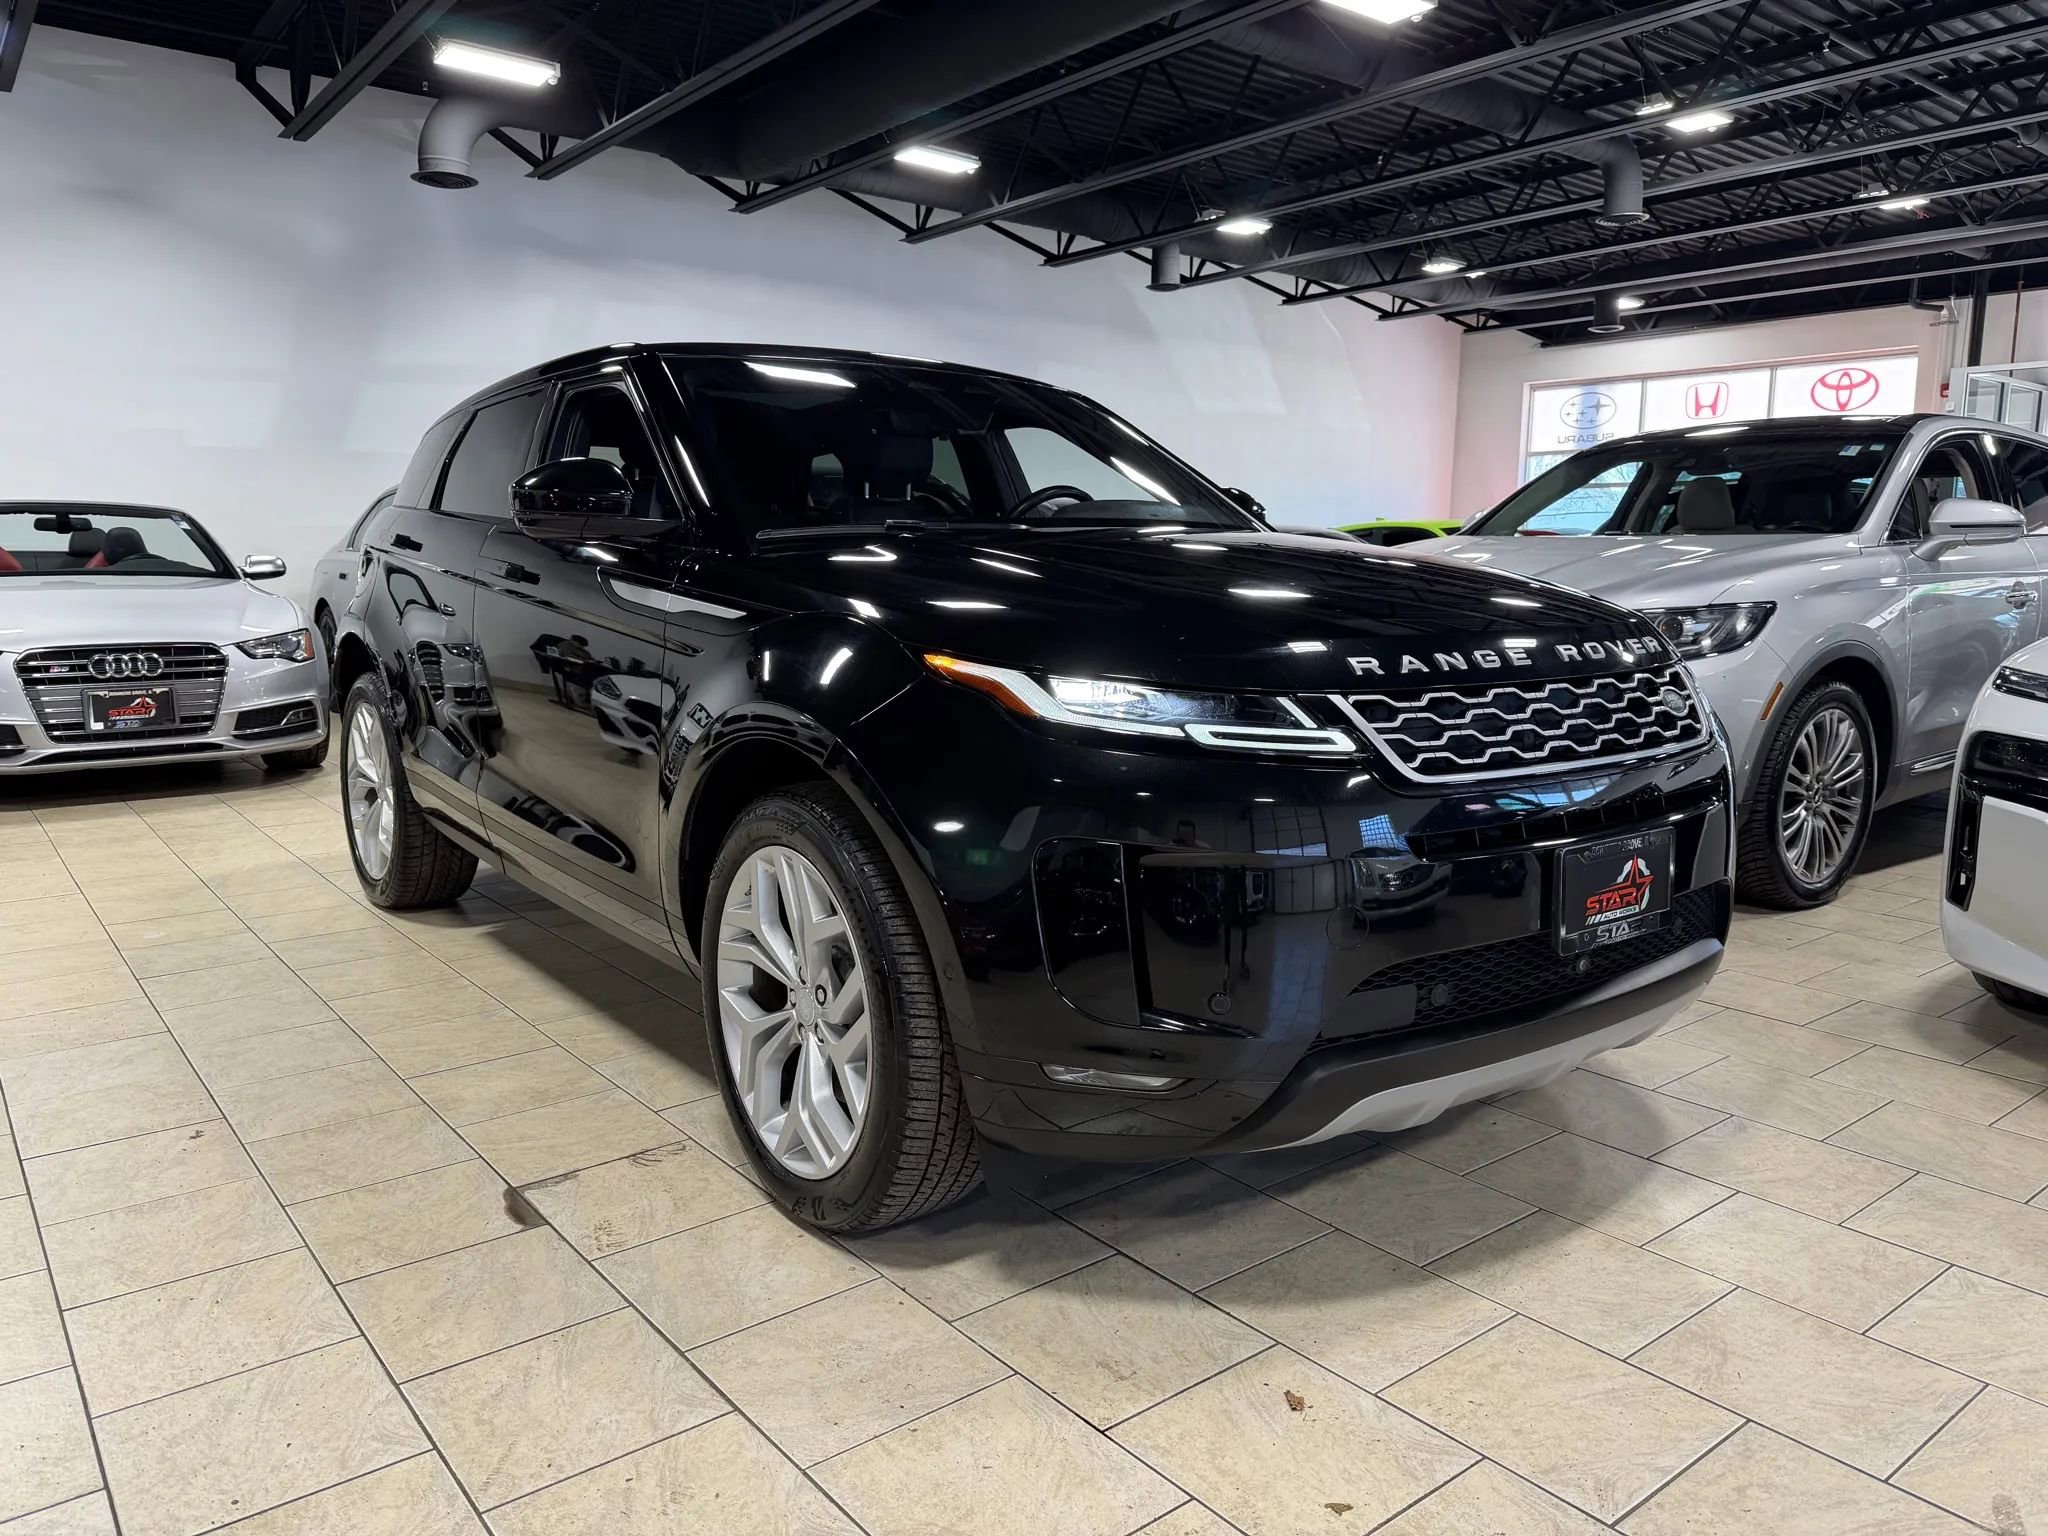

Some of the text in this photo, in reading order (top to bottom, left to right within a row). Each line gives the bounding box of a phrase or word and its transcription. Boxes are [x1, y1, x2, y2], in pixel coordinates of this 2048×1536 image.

[1346, 636, 1663, 676] RANGE ROVER
[108, 708, 146, 717] STAR
[1585, 887, 1637, 916] STAR
[1603, 911, 1618, 920] AUTO
